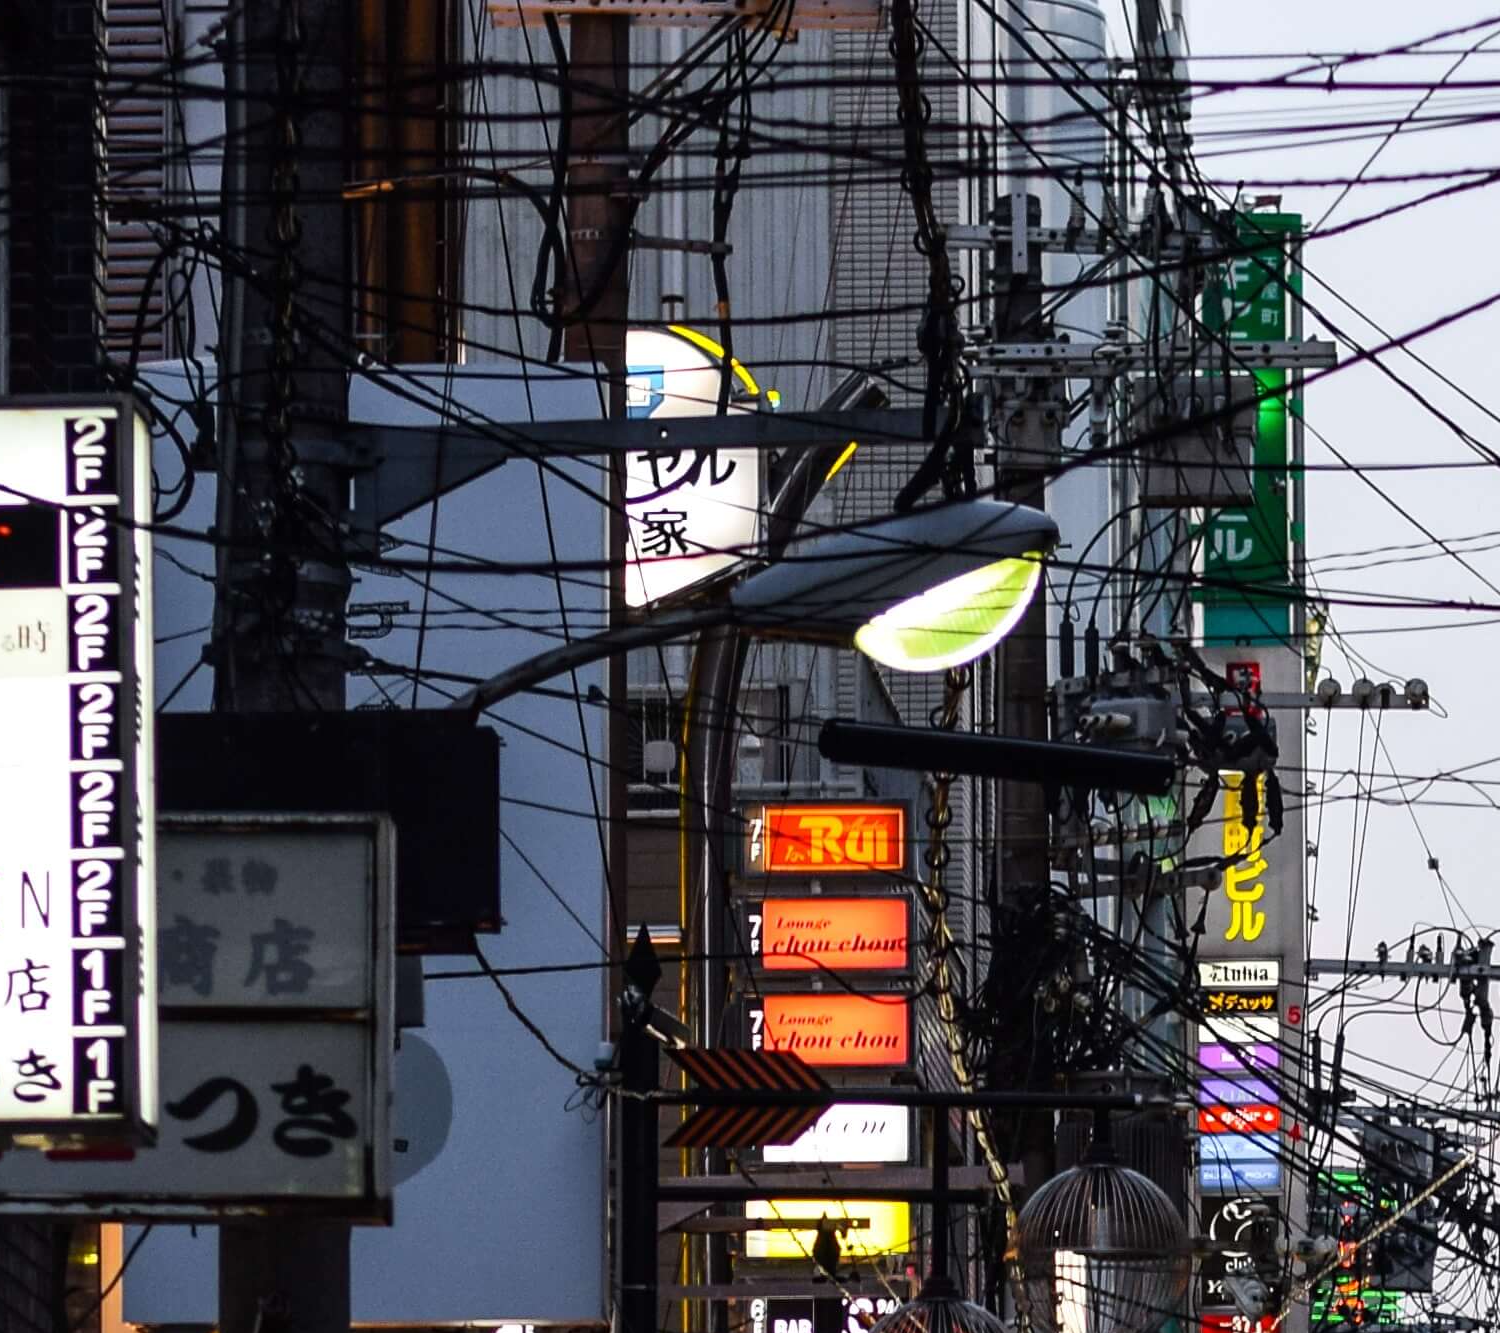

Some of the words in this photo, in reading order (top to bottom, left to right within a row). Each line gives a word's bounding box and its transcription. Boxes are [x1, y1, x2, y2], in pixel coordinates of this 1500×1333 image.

[73, 417, 106, 491] 2F
[641, 508, 688, 556] 家
[75, 594, 109, 671] 2F
[79, 684, 114, 760] 2F
[79, 772, 114, 848] 2F
[77, 860, 112, 936] 2F
[776, 916, 832, 932] Lounge
[83, 950, 112, 1025] 1F
[778, 1012, 834, 1028] Lounge
[87, 1038, 115, 1114] 1F
[165, 1063, 359, 1157] つき
